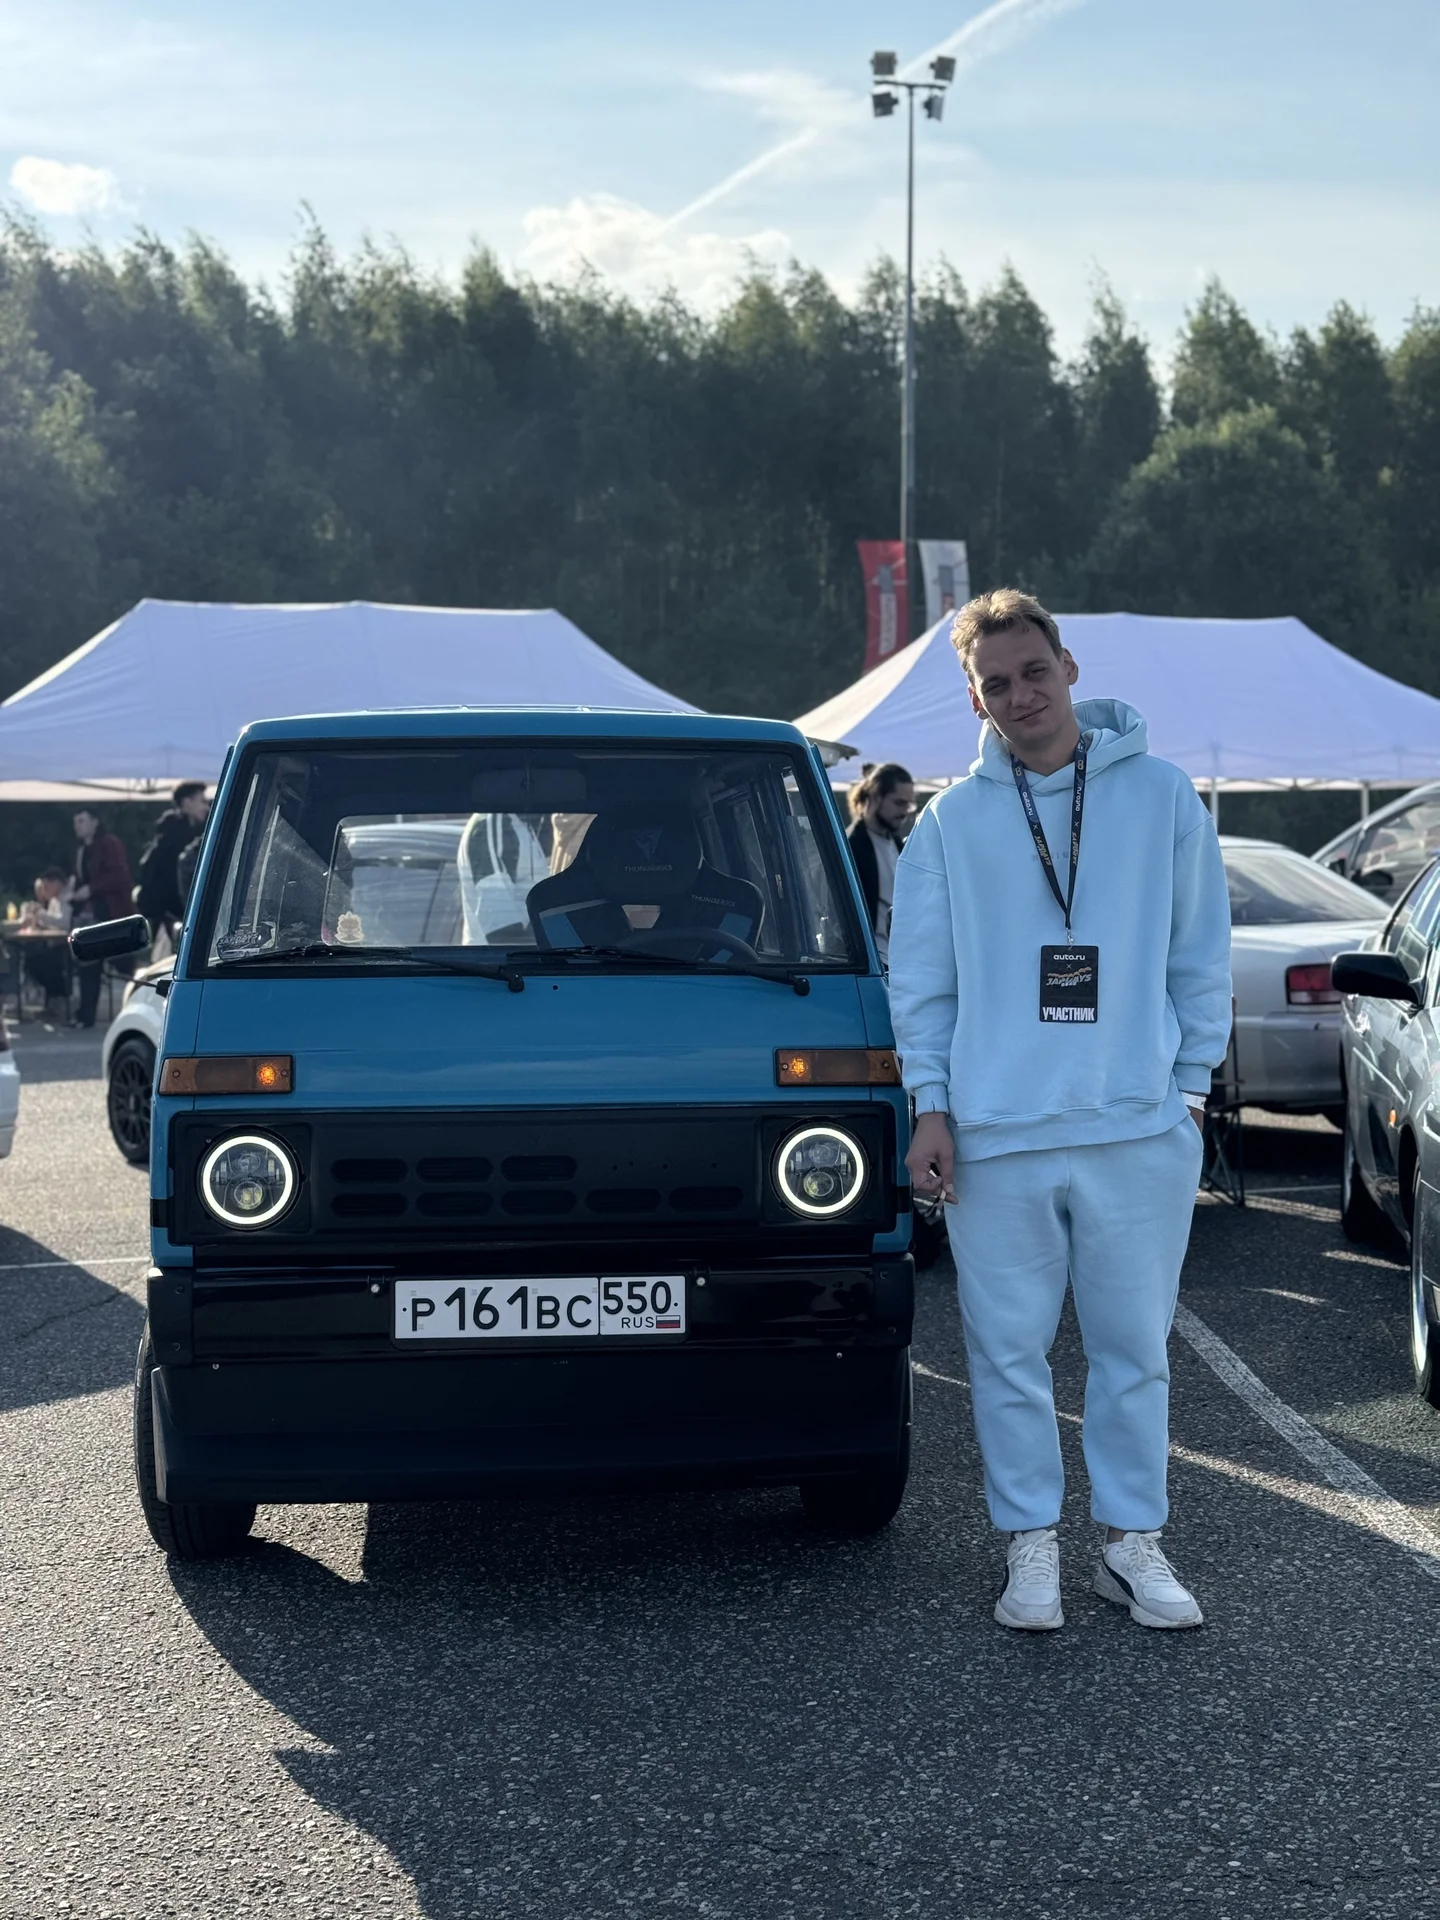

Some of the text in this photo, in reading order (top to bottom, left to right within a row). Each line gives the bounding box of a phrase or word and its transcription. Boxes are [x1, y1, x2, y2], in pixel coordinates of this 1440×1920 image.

[1022, 791, 1034, 816] auto.ru
[1074, 787, 1082, 812] auto.ru
[1042, 1007, 1095, 1021] УЧАСТНИК
[602, 1281, 672, 1315] 550
[621, 1316, 654, 1329] RUS
